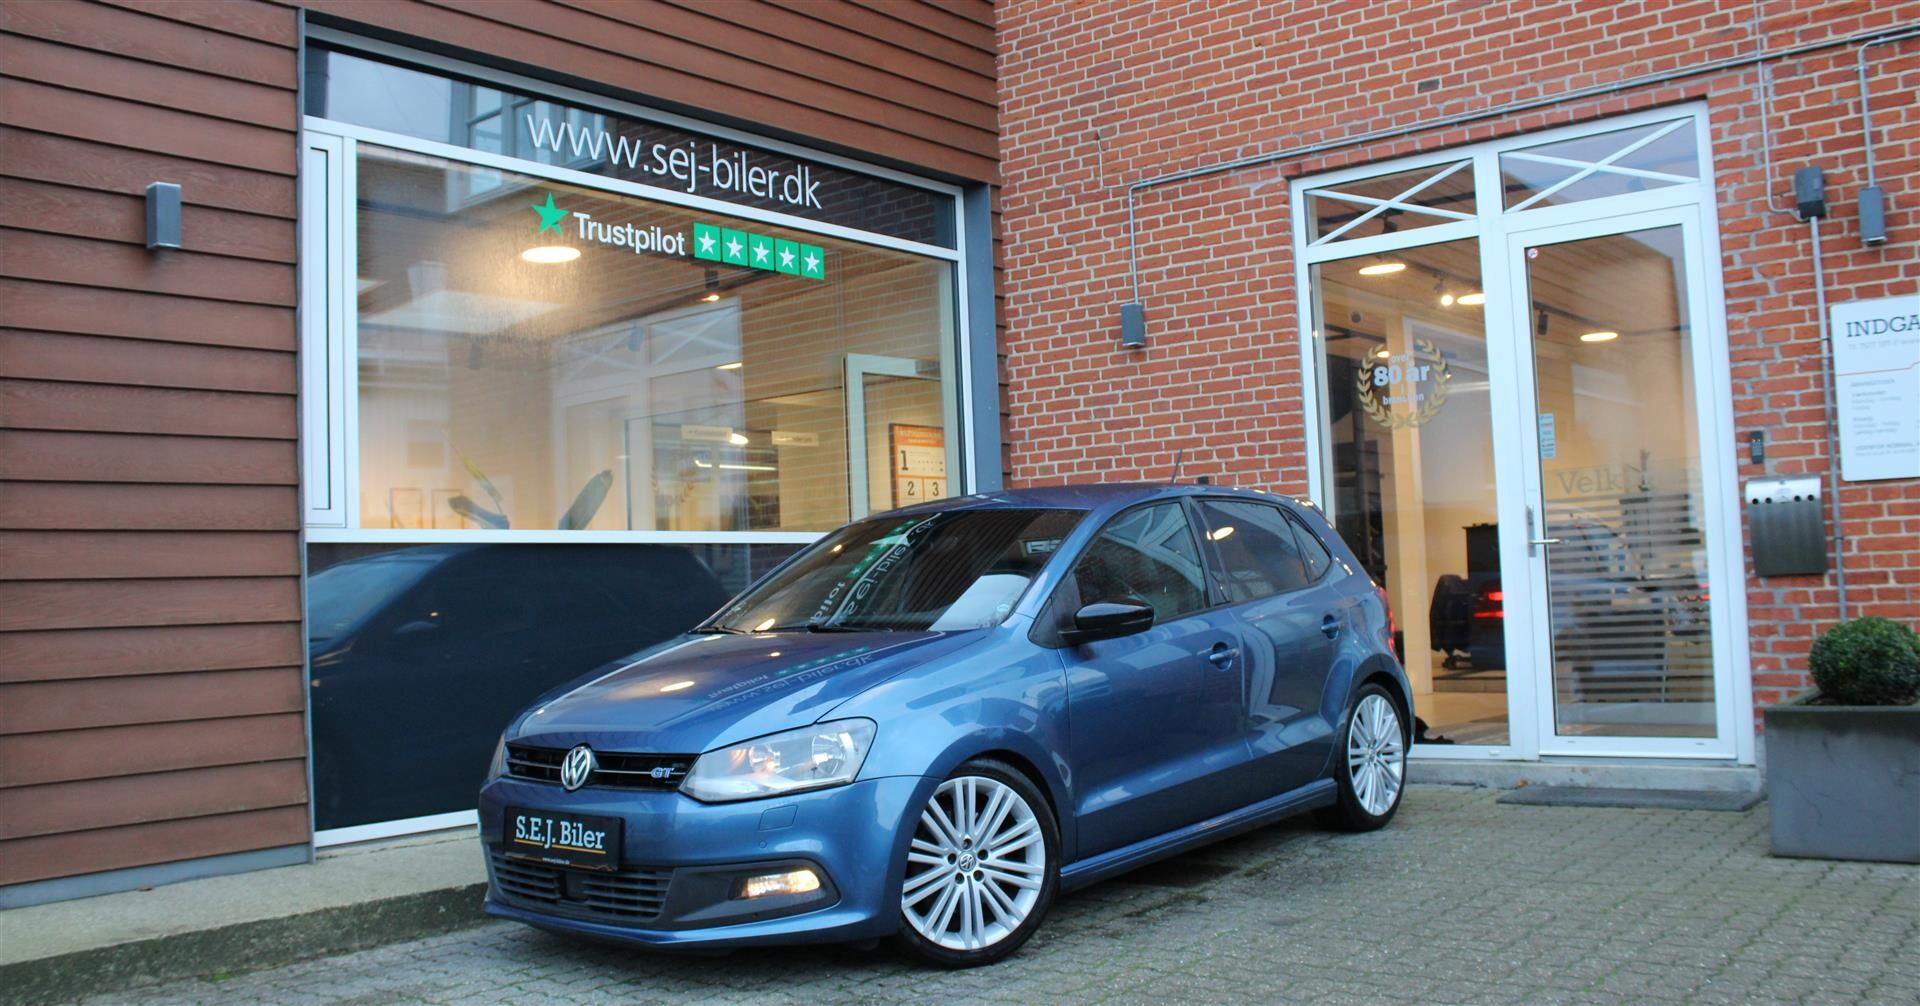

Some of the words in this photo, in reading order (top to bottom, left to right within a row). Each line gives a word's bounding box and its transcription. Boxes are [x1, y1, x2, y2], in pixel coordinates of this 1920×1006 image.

[526, 113, 823, 210] www.sej-biler.dk
[572, 211, 686, 256] Trustpilot
[1373, 364, 1402, 387] 80
[900, 450, 909, 471] 1
[907, 480, 915, 496] 2
[932, 481, 940, 497] 3
[650, 766, 675, 778] GT
[515, 815, 557, 849] S.E.J.
[559, 820, 605, 849] Biler
